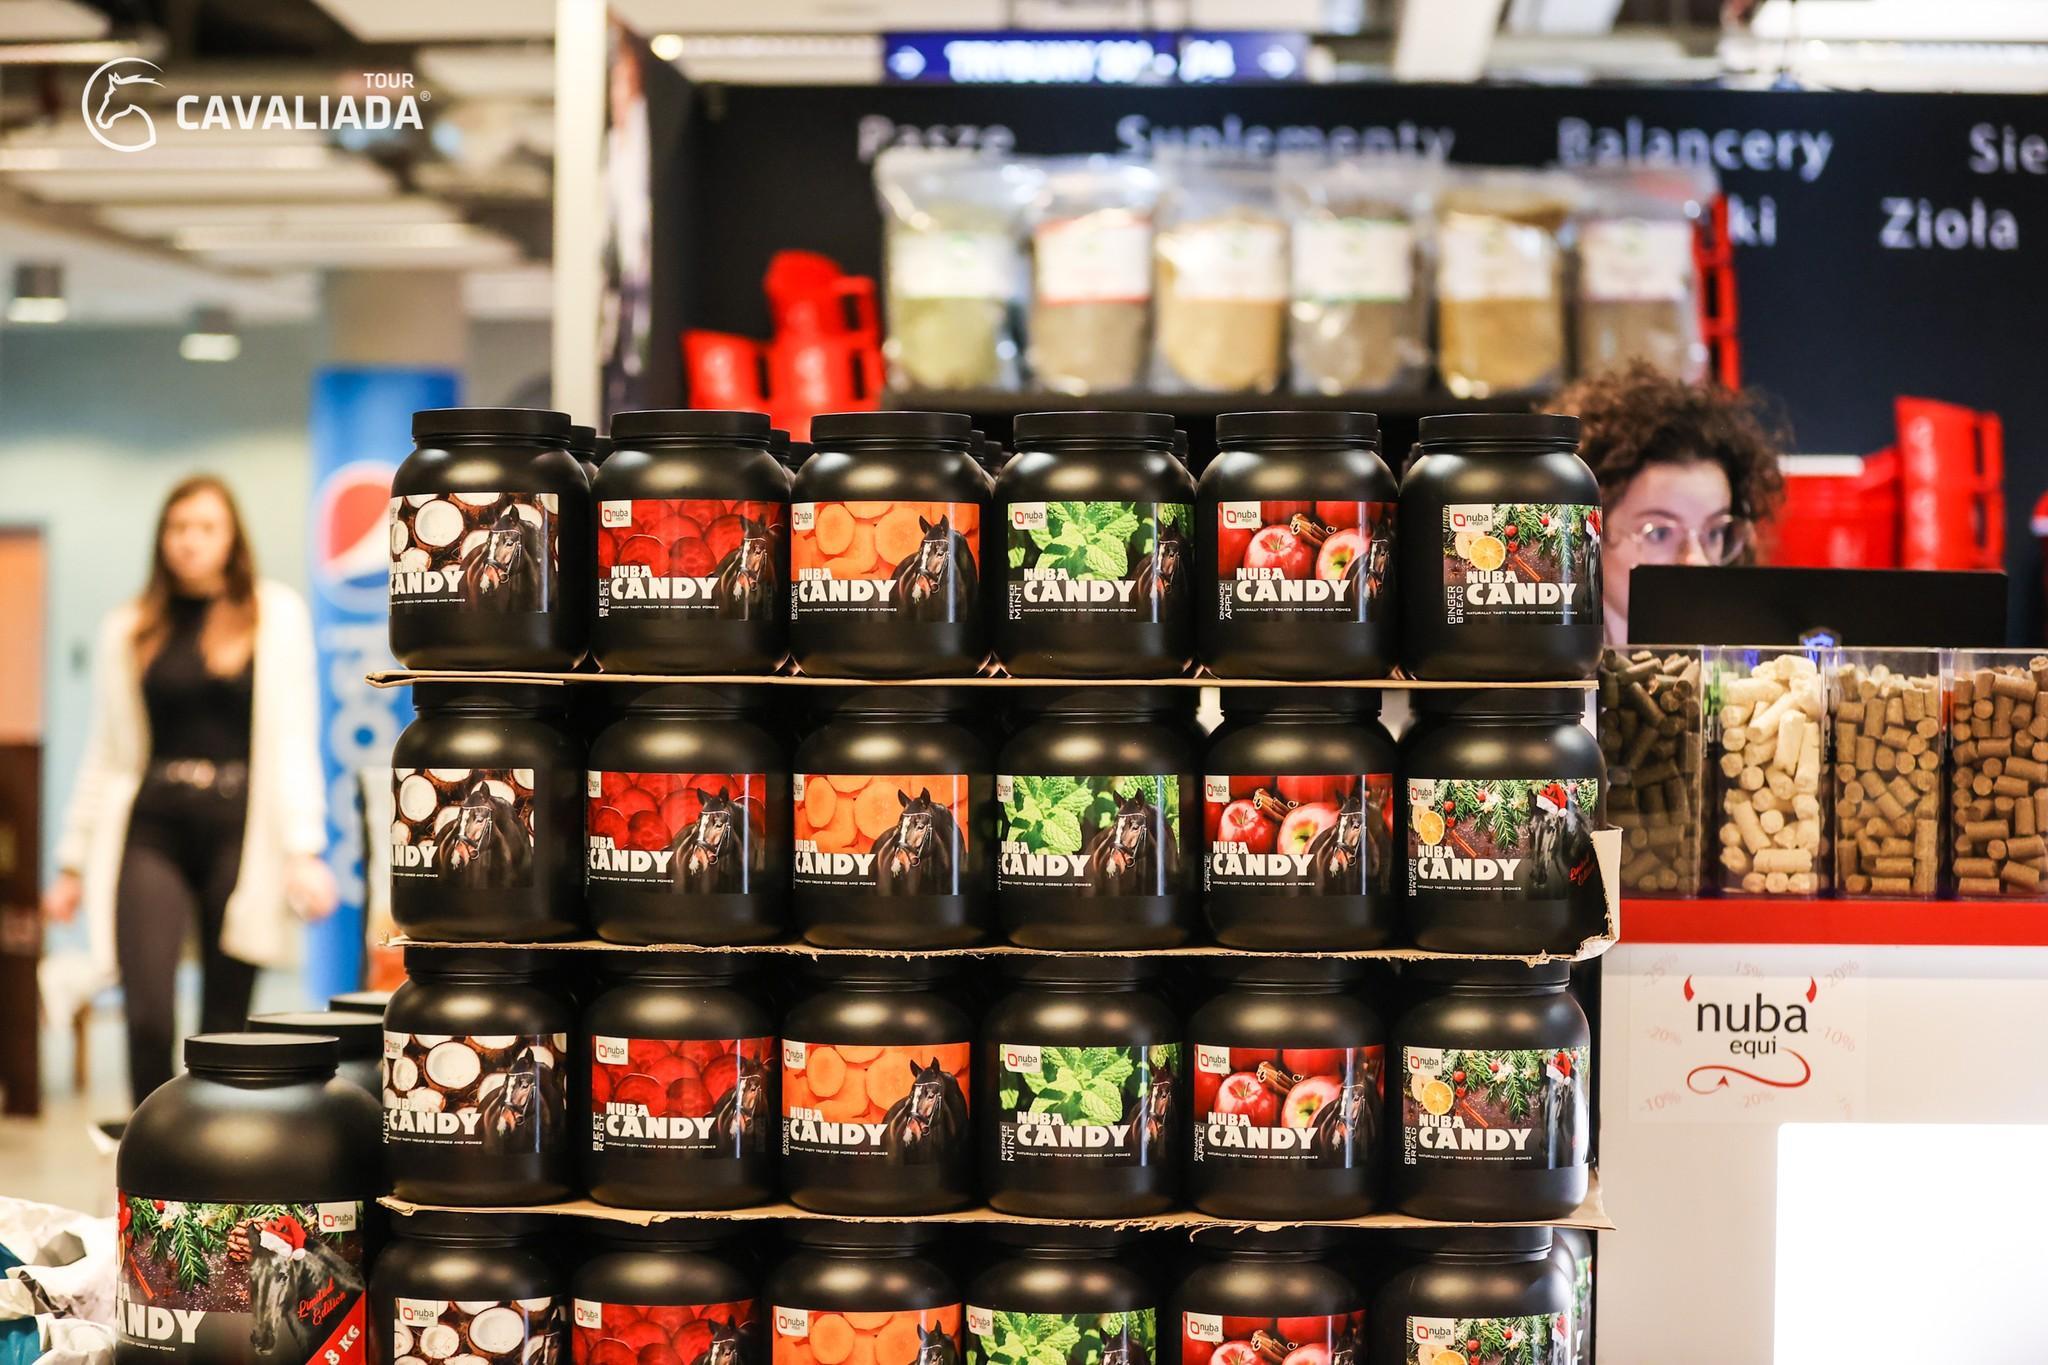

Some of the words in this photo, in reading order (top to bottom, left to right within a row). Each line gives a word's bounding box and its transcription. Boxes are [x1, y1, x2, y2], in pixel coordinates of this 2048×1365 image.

[612, 508, 629, 517] nuba
[1024, 510, 1043, 520] nuba
[1237, 510, 1257, 519] nuba
[1466, 513, 1489, 523] nuba
[611, 565, 653, 579] NUBA
[799, 568, 832, 581] NUBA
[1024, 568, 1069, 581] NUBA
[1236, 567, 1285, 581] NUBA
[1466, 570, 1519, 584] NUBA
[611, 577, 720, 600] CANDY
[799, 580, 897, 602] CANDY
[1024, 580, 1137, 602] CANDY
[1236, 580, 1350, 602] CANDY
[1466, 583, 1577, 605] CANDY
[1014, 586, 1022, 620] MINT
[1225, 583, 1233, 620] APPLE
[1448, 585, 1456, 625] GINGER
[392, 845, 438, 868] NDY
[1213, 841, 1249, 854] NUBA
[1417, 845, 1455, 859] NUBA
[590, 847, 674, 873] CANDY
[795, 851, 876, 876] CANDY
[1001, 853, 1092, 877] CANDY
[1213, 853, 1315, 877] CANDY
[1417, 858, 1522, 881] CANDY
[1697, 993, 1808, 1033] nuba
[608, 1046, 625, 1055] nuba
[1018, 1053, 1038, 1064] nuba
[1729, 1036, 1777, 1059] equi
[1208, 1055, 1226, 1065] nuba
[1420, 1057, 1439, 1066] nuba
[606, 1101, 650, 1118] NUBA
[790, 1106, 824, 1122] NUBA
[1017, 1111, 1064, 1126] NUBA
[1208, 1111, 1251, 1127] NUBA
[389, 1109, 482, 1136] CANDY
[606, 1115, 716, 1140] CANDY
[790, 1119, 888, 1146] CANDY
[1418, 1114, 1465, 1129] NUBA
[1007, 1127, 1015, 1162] MINT
[1017, 1124, 1131, 1148] CANDY
[1208, 1125, 1318, 1150] CANDY
[1418, 1126, 1532, 1151] CANDY
[116, 1299, 207, 1344] ANDY
[414, 1307, 434, 1318] nuba
[787, 1316, 805, 1327] nuba
[1200, 1323, 1219, 1332] nuba
[1429, 1326, 1451, 1336] nuba
[324, 1349, 340, 1365] 8
[338, 1325, 360, 1352] KG
